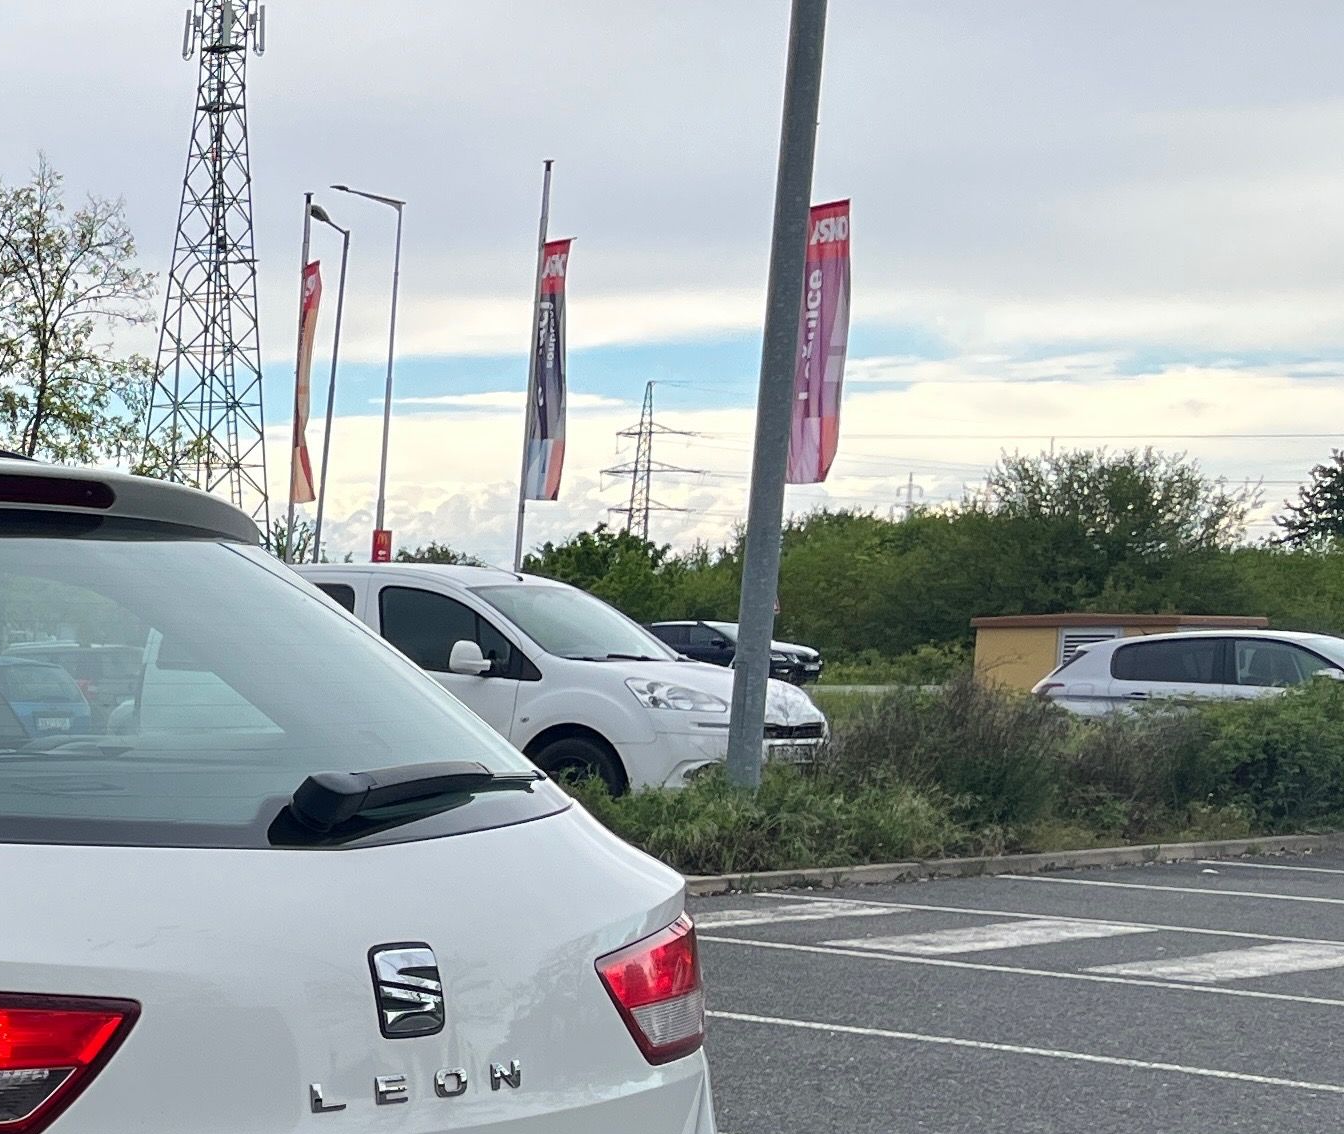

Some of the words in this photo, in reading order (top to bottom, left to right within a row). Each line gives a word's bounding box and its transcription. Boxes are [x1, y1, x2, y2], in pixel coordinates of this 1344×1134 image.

[810, 215, 849, 246] ASKO
[542, 253, 567, 279] ASK
[310, 1059, 521, 1113] LEON
